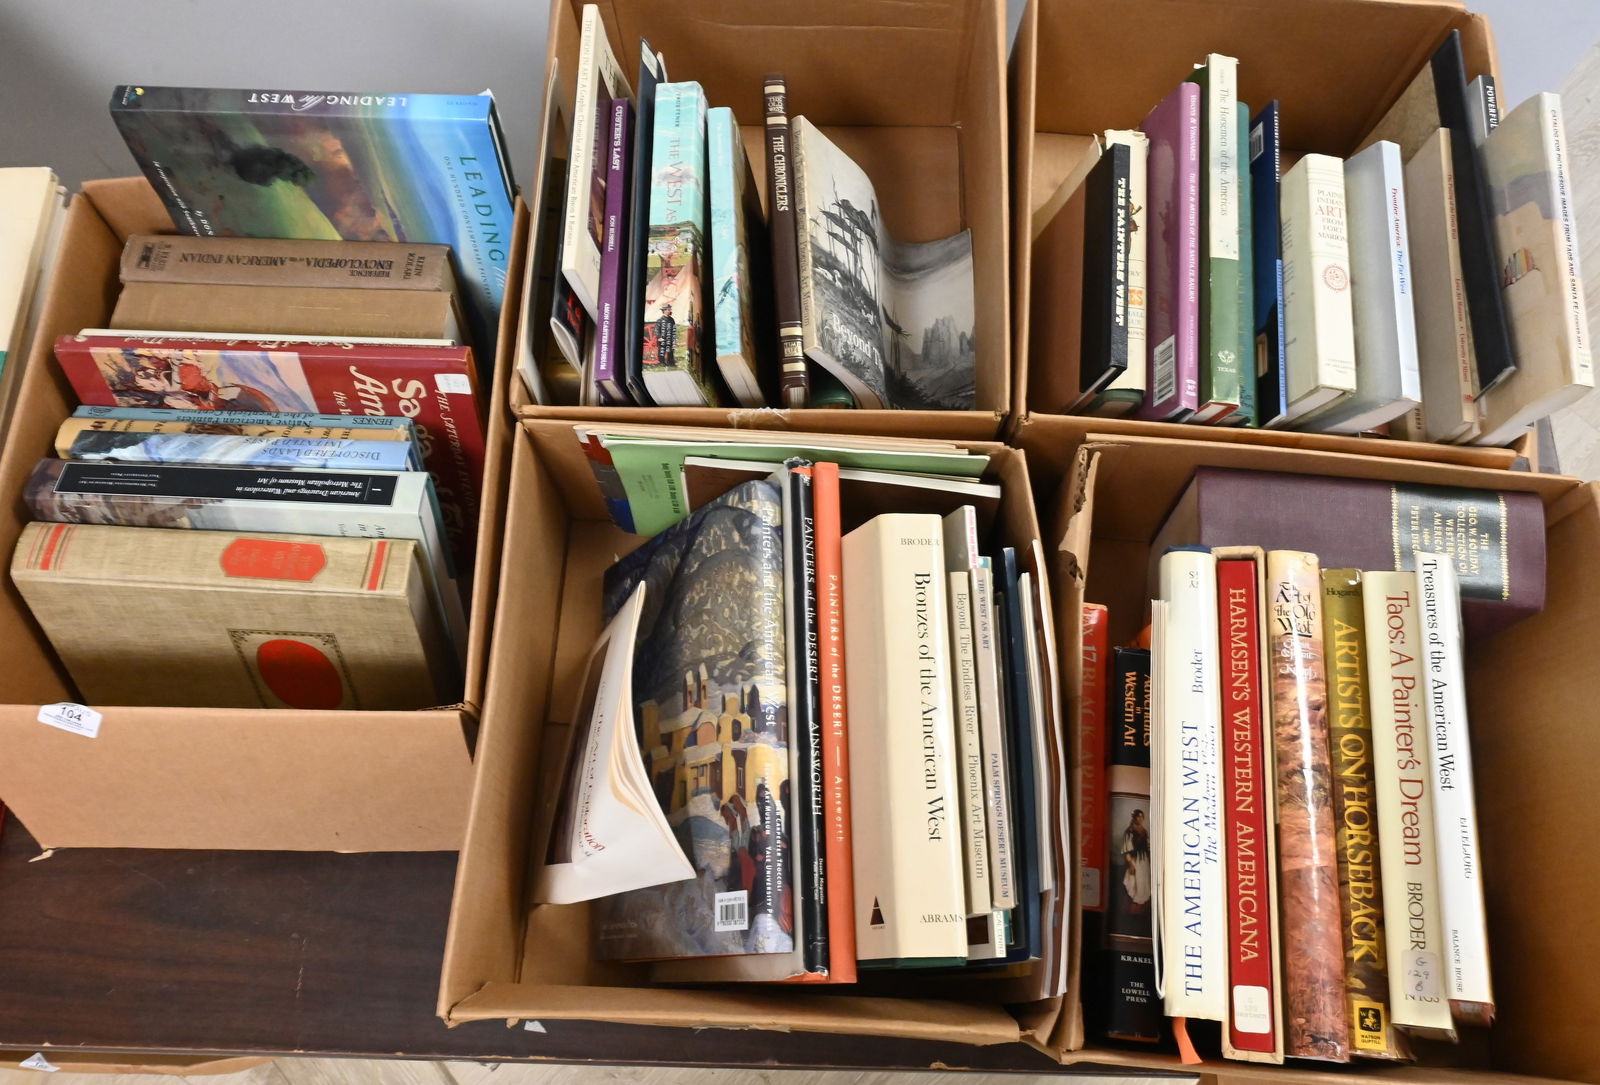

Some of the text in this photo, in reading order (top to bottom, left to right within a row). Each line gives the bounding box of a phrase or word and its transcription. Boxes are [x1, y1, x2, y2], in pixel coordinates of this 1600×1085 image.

[583, 34, 592, 54] BISON
[584, 19, 593, 32] THE
[583, 55, 591, 64] IN
[248, 93, 408, 107] LEADING WEST
[577, 90, 587, 113] Graphic
[1219, 88, 1230, 102] The
[1486, 85, 1499, 128] POWERFUL
[575, 114, 586, 144] Chronicle
[611, 105, 622, 171] CUSTER'S LAST
[1219, 106, 1230, 147] Horsemen
[574, 152, 583, 163] the
[1219, 150, 1231, 159] of
[1220, 161, 1231, 174] the
[573, 164, 582, 194] American
[666, 138, 684, 222] THE WEST AS
[772, 135, 788, 212] THE CHRONICLERS
[443, 156, 483, 265] ONE HUNDRED CONTEMPORARY
[460, 156, 504, 262] LEADING
[1220, 178, 1231, 216] Americas
[1315, 204, 1343, 219] ART
[1550, 109, 1579, 309] CATALOG IMAGES FROM TAOS AND SANTA FE
[607, 215, 616, 252] DON RUSSELL
[794, 130, 811, 327] Beyond The Endless Phoenix Art Museum
[1391, 188, 1407, 295] Frontier The West
[179, 252, 224, 265] INDIAN
[227, 254, 288, 267] AMERICAN
[306, 258, 393, 270] ENCYCLOPEDIA
[1115, 178, 1126, 326] THE WEST
[600, 302, 611, 370] AMON CARTER MUSEUM
[832, 311, 873, 358] Beyond
[434, 390, 451, 412] THE
[175, 414, 312, 428] Native American Painters
[352, 417, 394, 426] HENKES
[262, 448, 381, 461] DISCOVERED LANDS
[243, 486, 361, 498] American Drawings and Watercolors
[256, 477, 363, 489] The Metropolitan Museum of Art
[1457, 506, 1468, 575] COLLECTION OF
[1480, 532, 1489, 550] THE
[1292, 604, 1315, 621] Old
[1421, 560, 1440, 629] Treasures
[761, 507, 780, 727] Painters and the American West
[1272, 618, 1311, 635] West
[1081, 645, 1097, 662] 17
[1228, 588, 1250, 701] HARMSEN'S
[1430, 632, 1442, 647] of
[803, 516, 821, 816] PAINTERS of the DESERT AINSWORTH
[1189, 649, 1203, 693] Broder
[1431, 650, 1446, 672] the
[61, 707, 82, 721] 104
[828, 574, 844, 843] PAINTERS of the DESERT Ainsworth
[914, 572, 944, 843] Bronzes of the American West
[1123, 671, 1138, 747] Western Art
[1433, 679, 1452, 752] American
[957, 593, 985, 878] Beyond The Endless River Phoenix Art Museum
[978, 578, 1008, 897] THE WEST AS ART PALM SPRINGS DESERT MUSEUM
[1386, 591, 1425, 867] Taos: A Painter's Dream
[1232, 707, 1254, 814] WESTERN
[1439, 754, 1456, 791] West
[1334, 619, 1380, 964] ARTISTS ON HORSEBACK
[764, 805, 772, 835] MUSEUM
[1203, 773, 1217, 864] The Modern
[1181, 721, 1203, 997] THE AMERICAN WEST
[1236, 821, 1260, 964] AMERICANA
[919, 913, 963, 923] ABRAMS
[1407, 881, 1425, 951] BRODER
[1120, 954, 1152, 965] KRAKEL
[1452, 929, 1463, 993] BALANCE HOUSE
[1121, 988, 1150, 996] LOWELL
[1126, 995, 1147, 1003] PRESS
